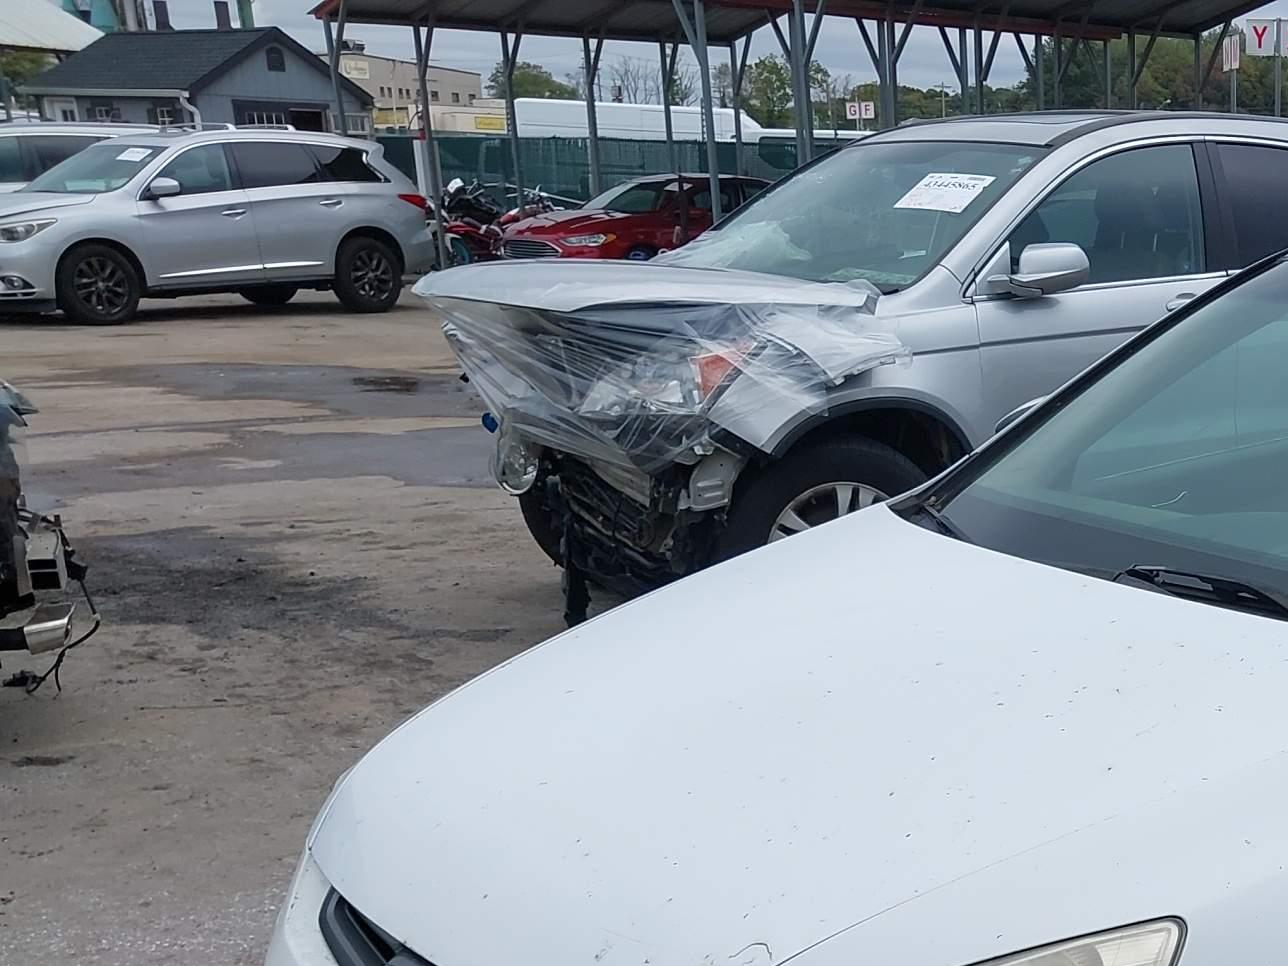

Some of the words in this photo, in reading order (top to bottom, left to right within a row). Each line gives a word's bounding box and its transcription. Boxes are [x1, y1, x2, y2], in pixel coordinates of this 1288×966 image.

[1252, 25, 1268, 49] Y
[849, 104, 857, 117] G
[864, 104, 871, 116] F
